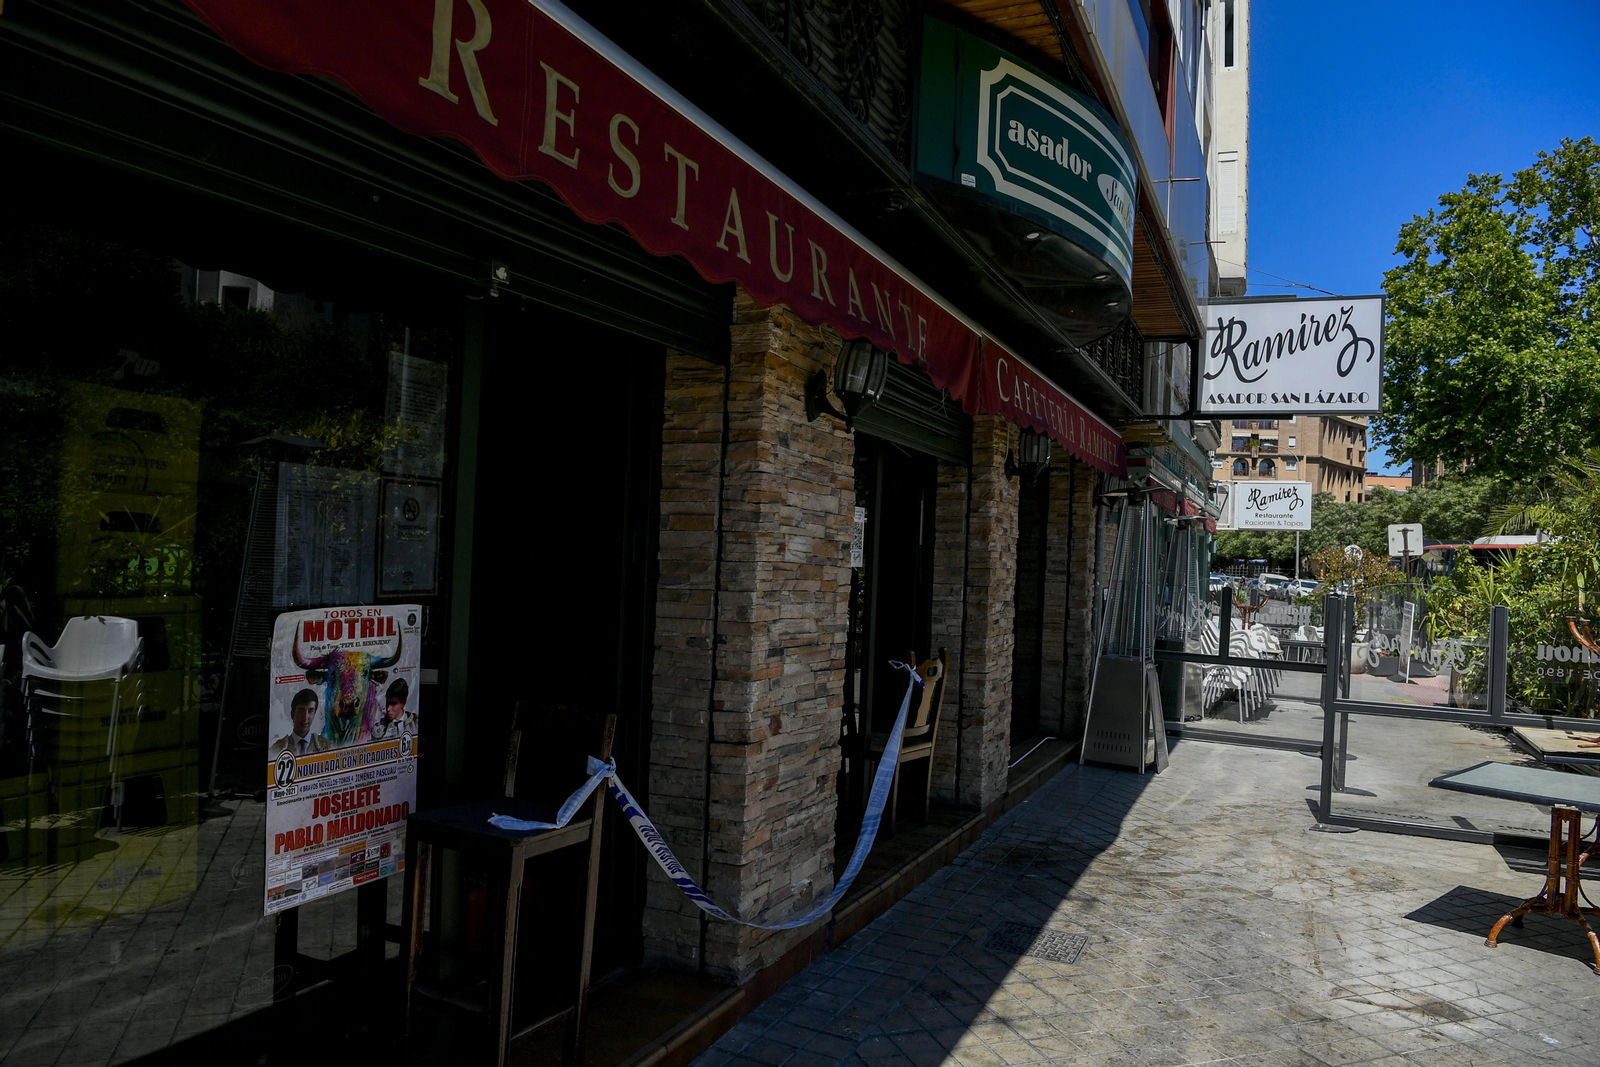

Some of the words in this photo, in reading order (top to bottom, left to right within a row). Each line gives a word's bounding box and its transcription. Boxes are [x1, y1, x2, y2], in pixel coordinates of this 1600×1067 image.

[1007, 119, 1093, 182] asador
[418, 0, 929, 364] RESTAURANTE
[997, 357, 1076, 444] CAFETERÍA
[1206, 393, 1267, 404] ASADOR
[1271, 393, 1300, 404] SAN
[1304, 390, 1370, 404] LÁZARO
[303, 616, 396, 642] MOTRIL
[324, 609, 363, 619] TOROS
[367, 609, 381, 617] EN
[278, 759, 295, 786] 22
[297, 758, 340, 778] NOVILLADA
[341, 755, 357, 769] CON
[358, 746, 398, 765] PICADORES
[303, 783, 318, 792] BRAVOS
[312, 784, 381, 819] JOSELETE
[275, 823, 324, 855] PABLO
[327, 801, 410, 841] MALDONADO
